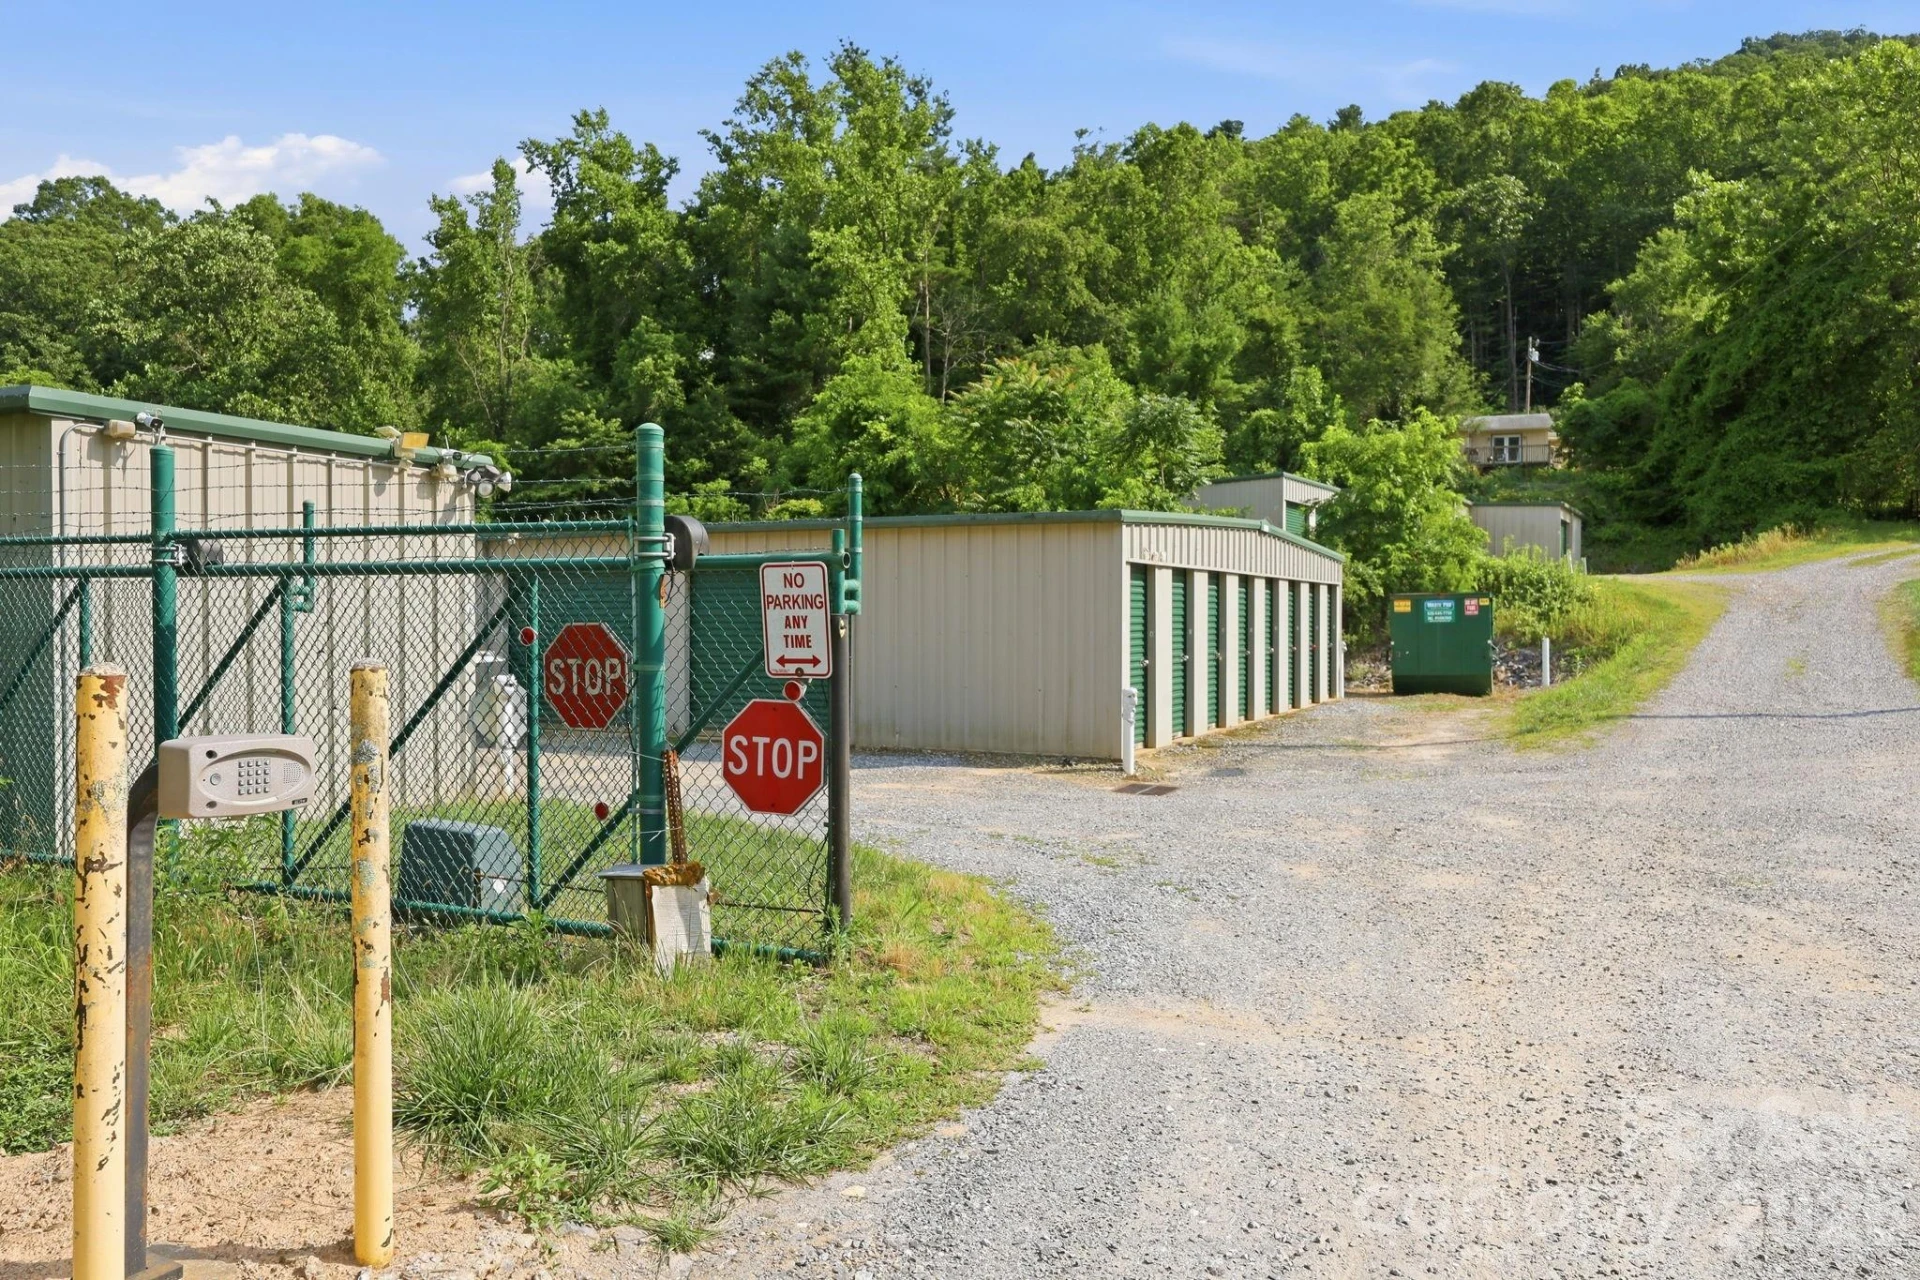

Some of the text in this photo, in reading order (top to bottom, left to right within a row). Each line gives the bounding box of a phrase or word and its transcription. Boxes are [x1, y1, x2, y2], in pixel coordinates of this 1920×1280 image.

[783, 572, 805, 589] NO
[766, 594, 824, 611] PARKING
[784, 615, 808, 629] ANY
[783, 635, 812, 649] TIME
[549, 658, 622, 696] STOP
[728, 734, 818, 780] STOP
